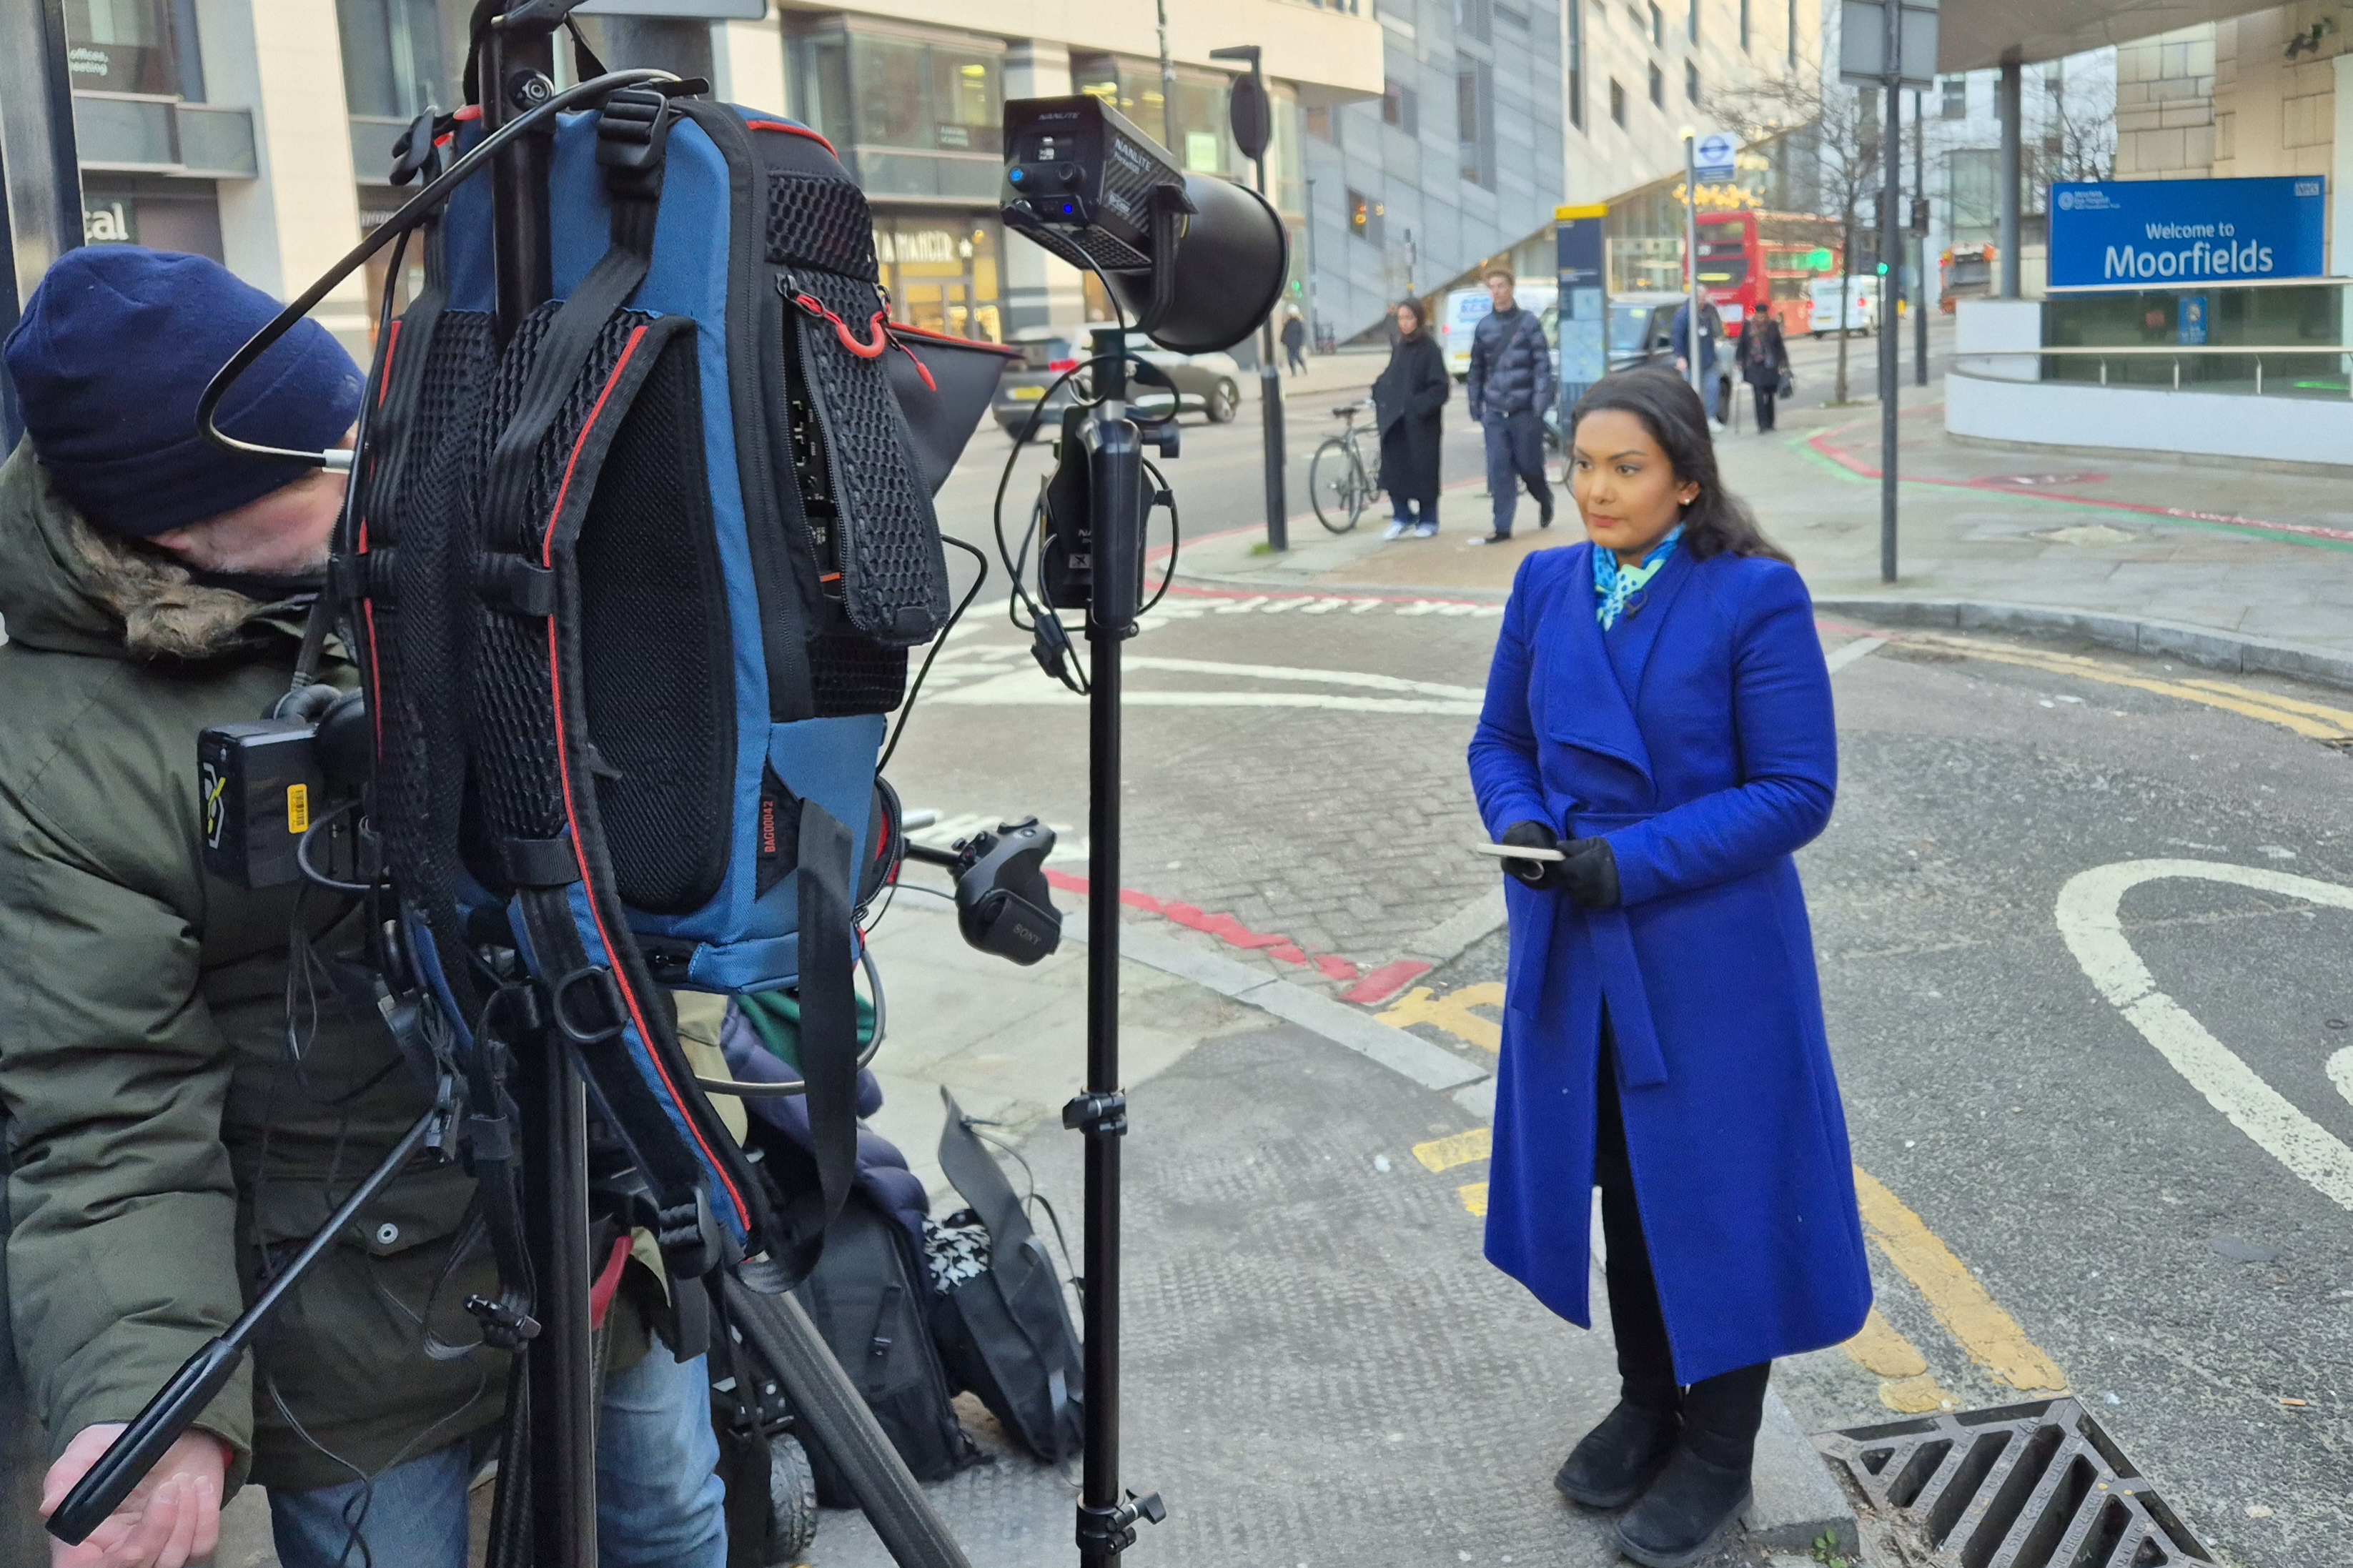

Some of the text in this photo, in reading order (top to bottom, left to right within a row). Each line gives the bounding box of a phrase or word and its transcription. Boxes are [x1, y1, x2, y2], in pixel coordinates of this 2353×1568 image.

[1115, 138, 1151, 172] NANLITE
[2146, 221, 2235, 239] Welcome to
[2104, 239, 2274, 279] Moorfields
[763, 801, 776, 852] BAG00042
[1013, 923, 1042, 945] SONY
